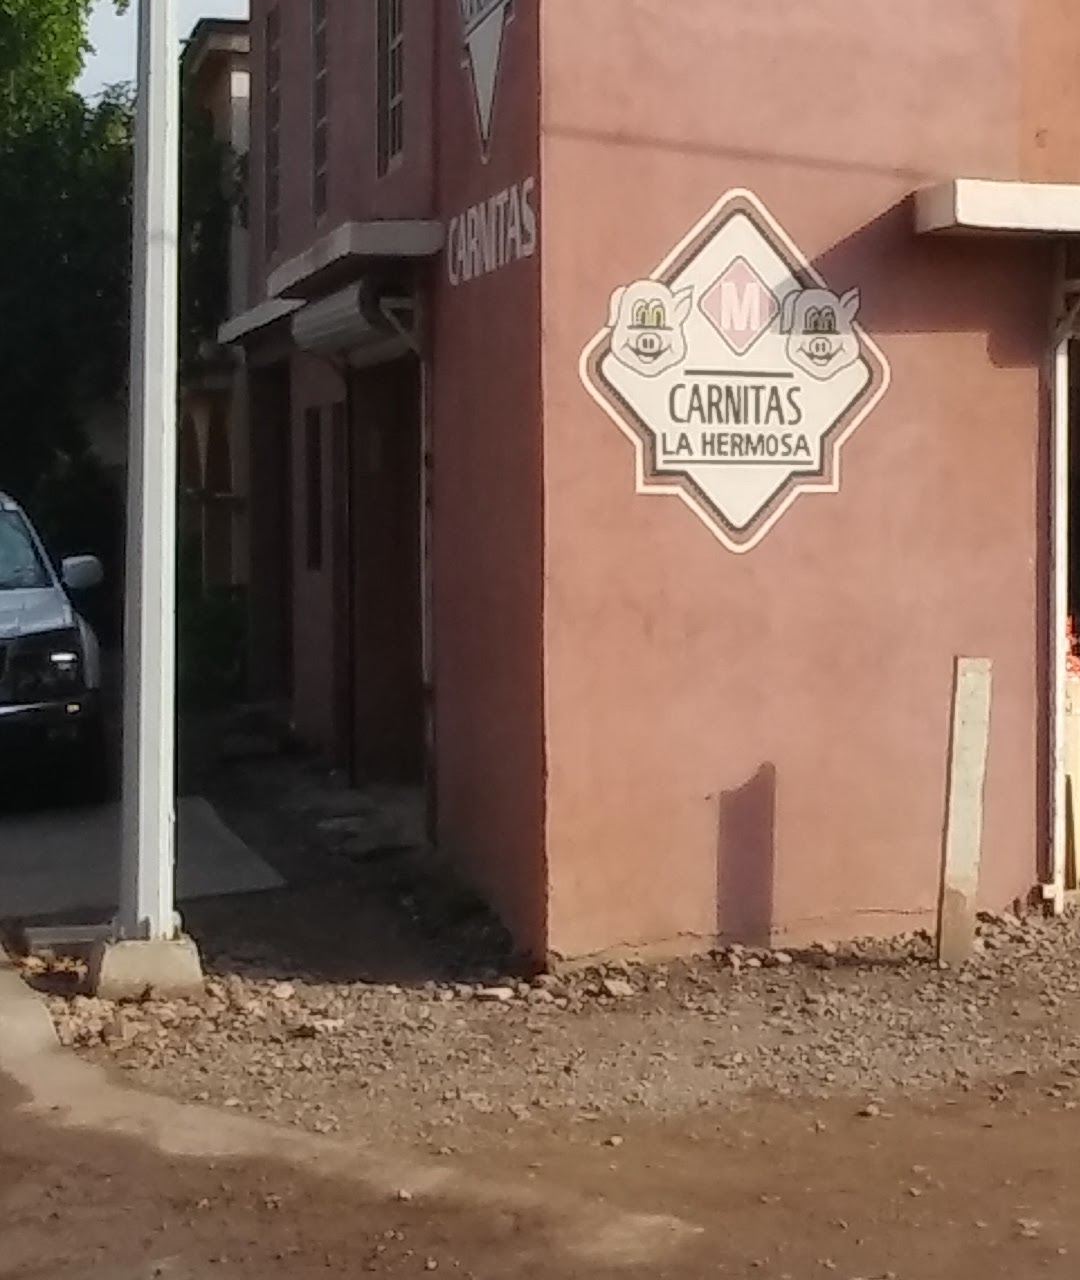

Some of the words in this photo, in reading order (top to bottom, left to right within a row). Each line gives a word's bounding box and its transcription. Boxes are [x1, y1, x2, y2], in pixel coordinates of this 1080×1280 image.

[448, 176, 536, 286] CARNITAS
[720, 282, 761, 332] M
[668, 383, 803, 426] CARNITAS
[662, 432, 694, 457] LA
[701, 432, 812, 458] HERMOSA
